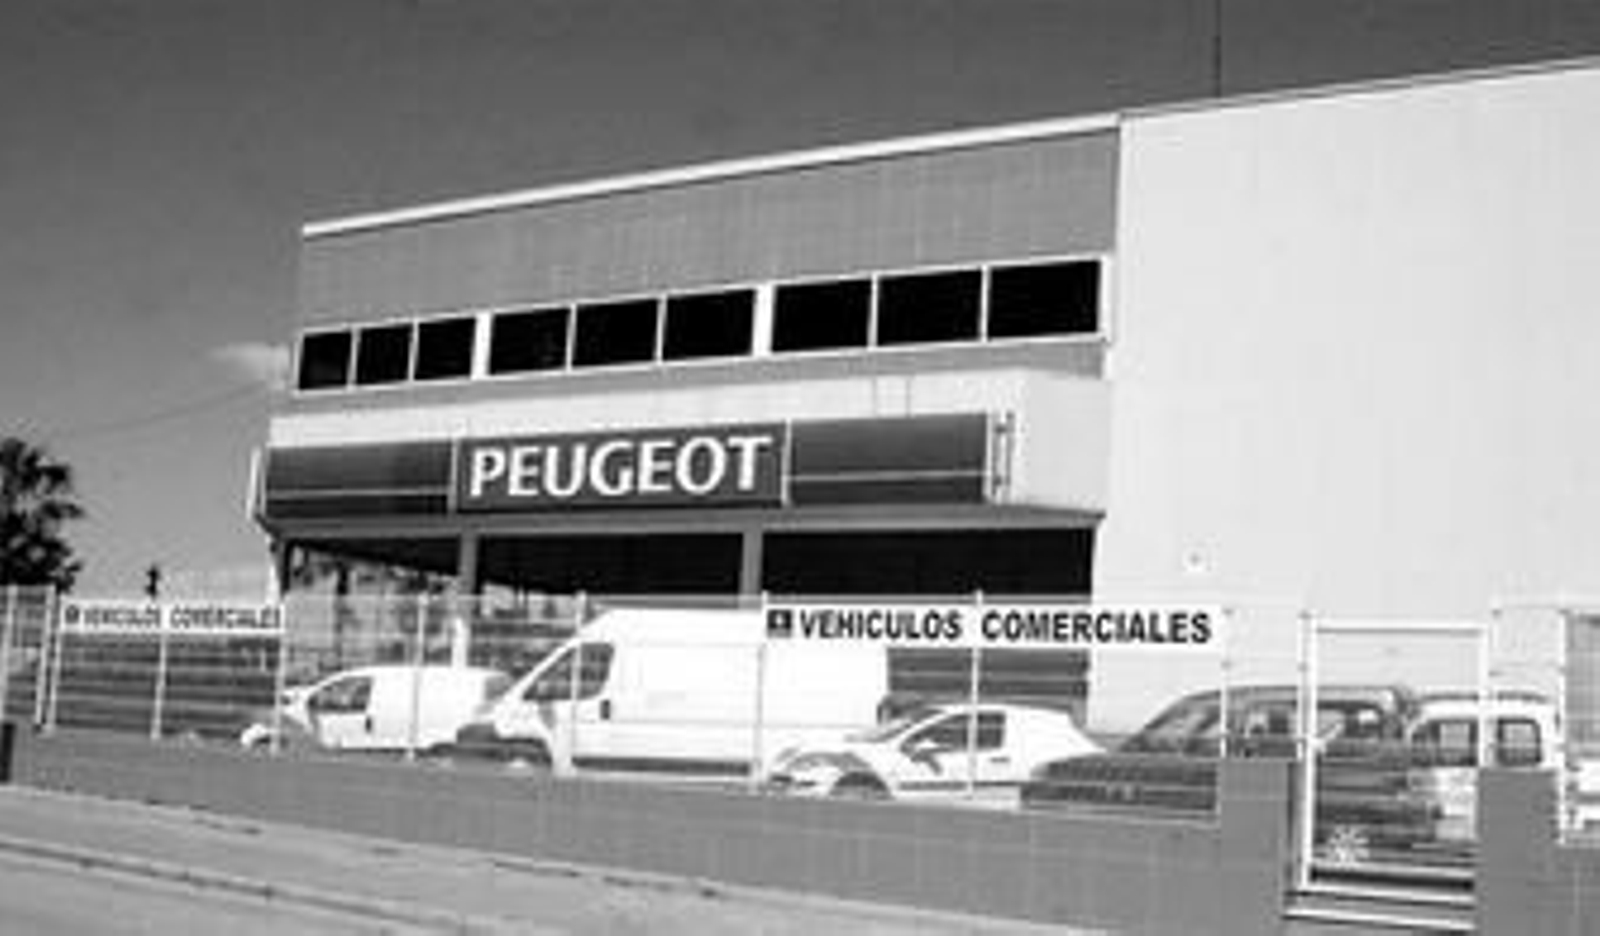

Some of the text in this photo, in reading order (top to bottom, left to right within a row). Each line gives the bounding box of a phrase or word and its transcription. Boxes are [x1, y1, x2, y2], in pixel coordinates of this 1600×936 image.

[470, 435, 773, 497] PEUGEOT
[800, 609, 1212, 643] VEHICULOS COMERCIALES
